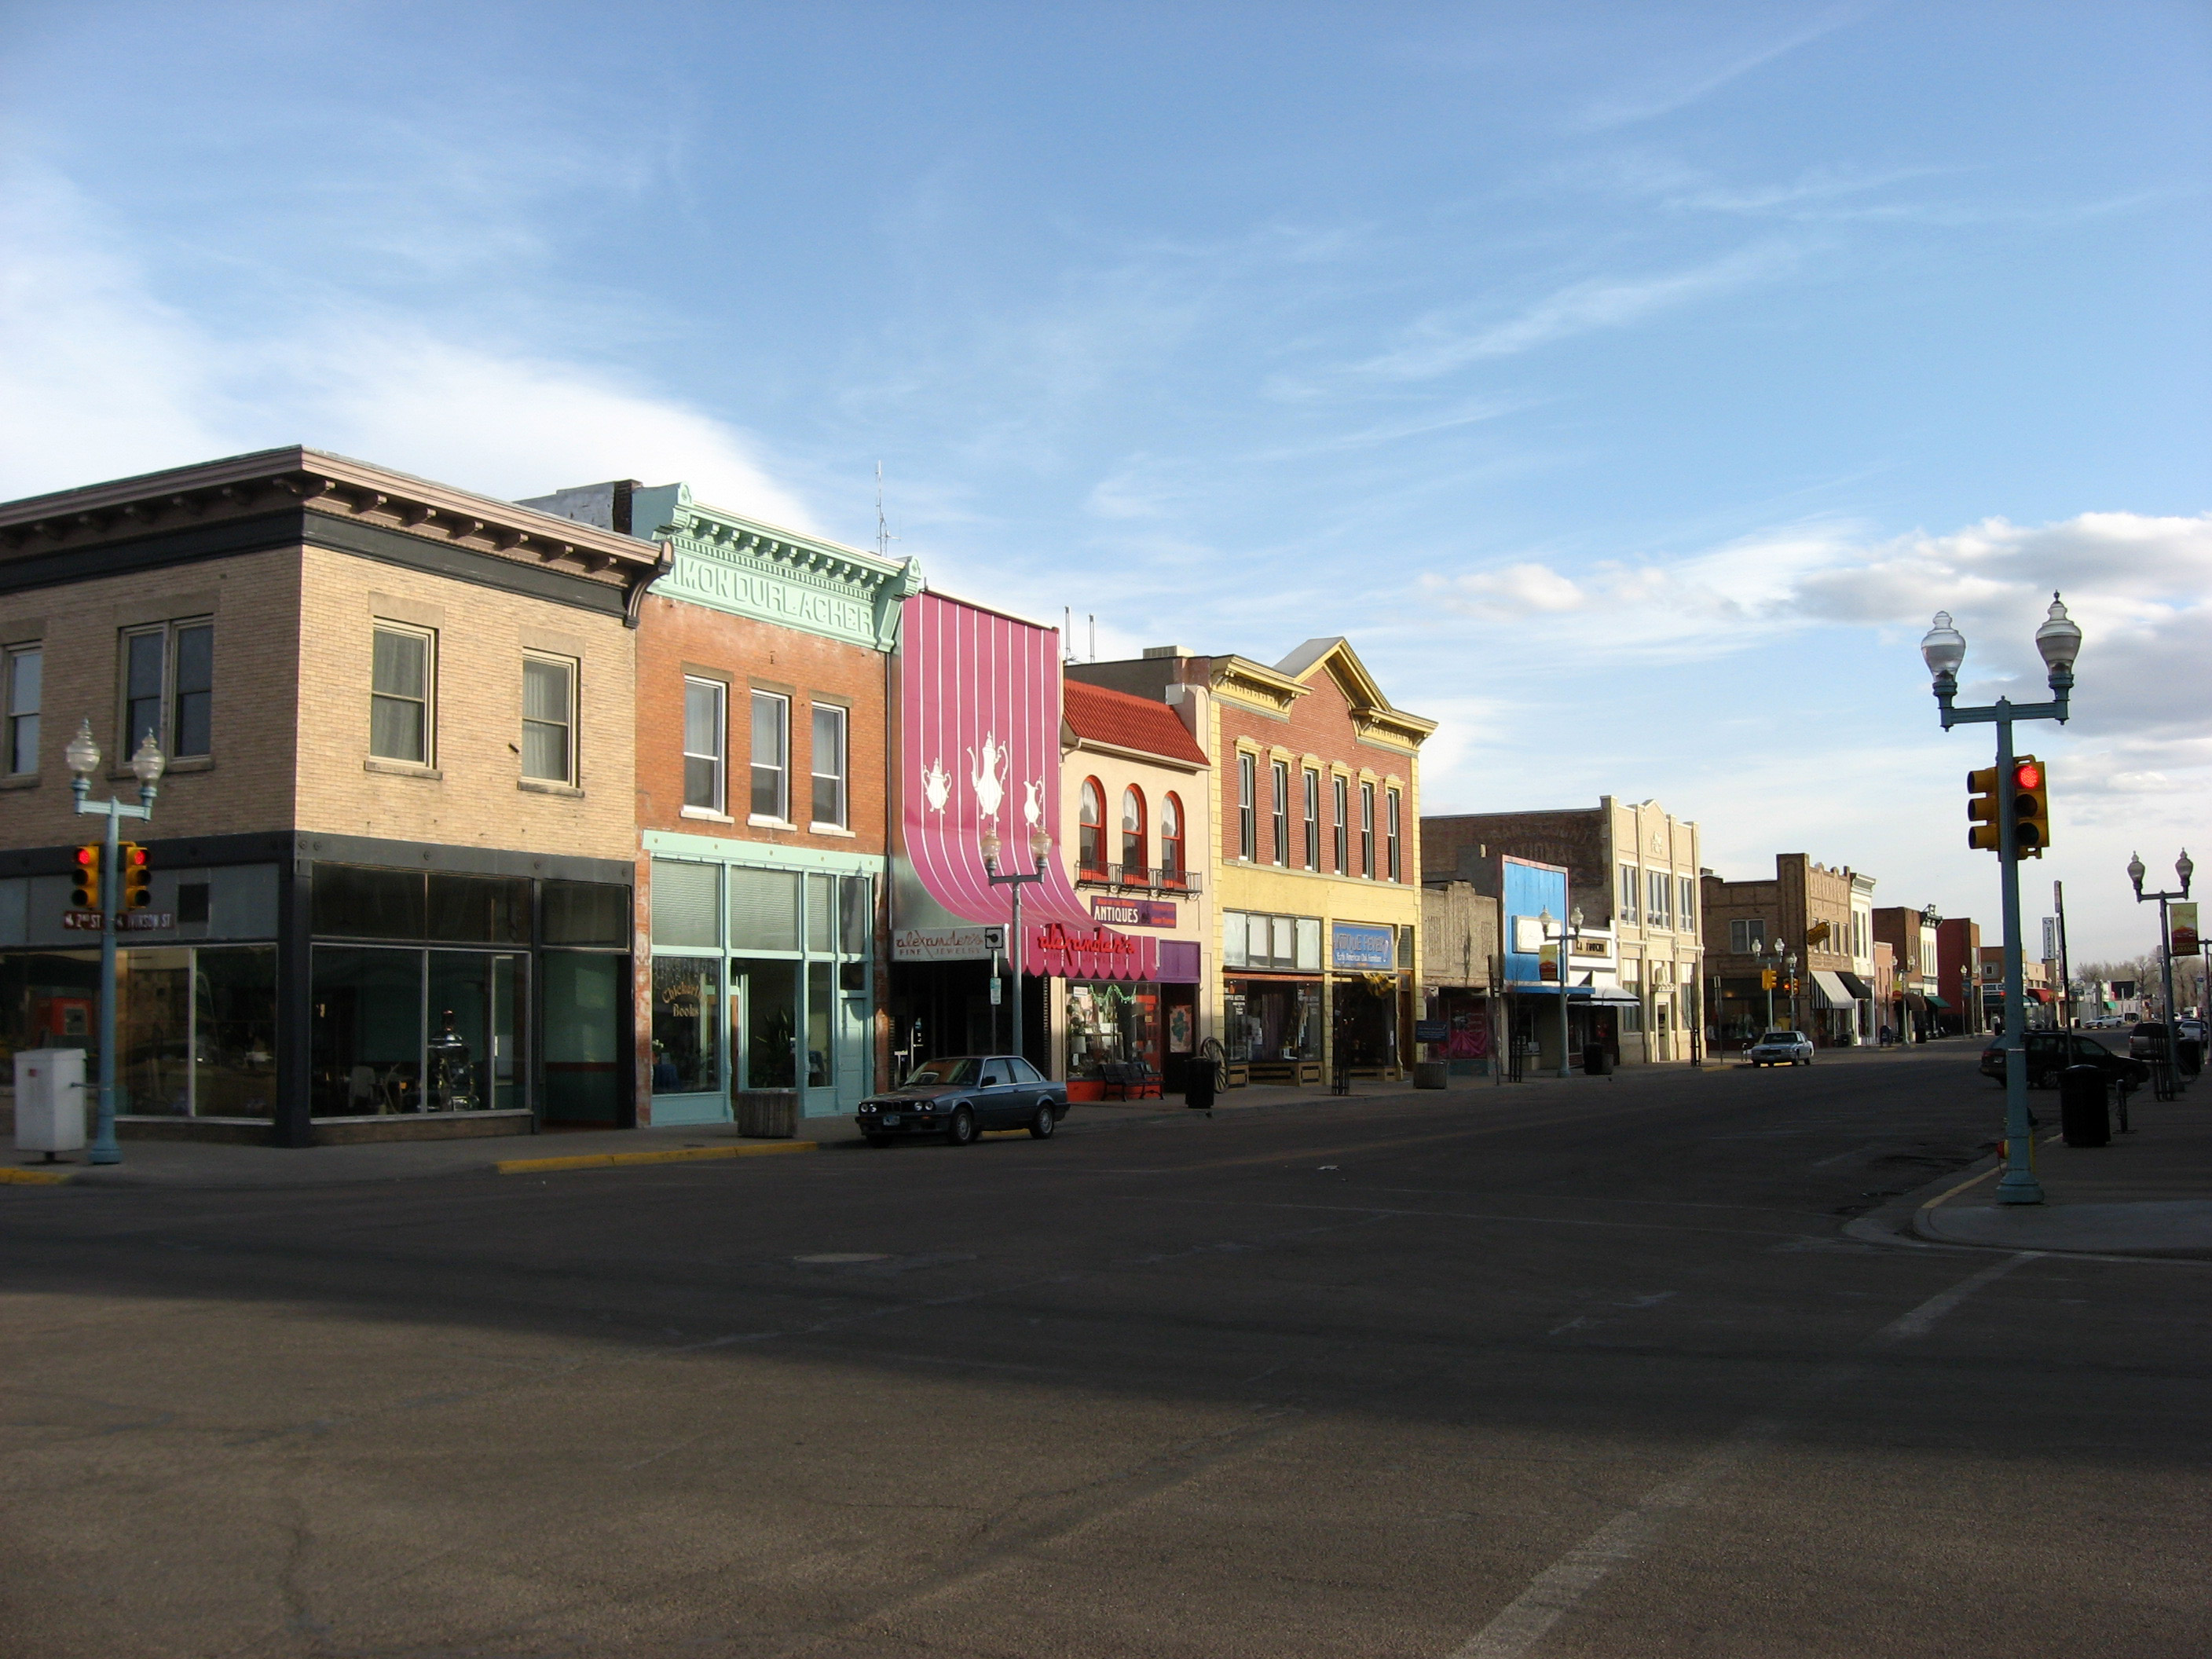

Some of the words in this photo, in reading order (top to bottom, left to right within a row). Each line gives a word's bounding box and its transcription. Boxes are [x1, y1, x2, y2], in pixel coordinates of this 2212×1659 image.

[661, 555, 729, 599] IMON
[734, 572, 872, 635] DURLACHER
[90, 914, 101, 928] ST
[160, 914, 171, 928] ST
[1093, 905, 1140, 924] ANTIQUES
[673, 1003, 700, 1017] Books
